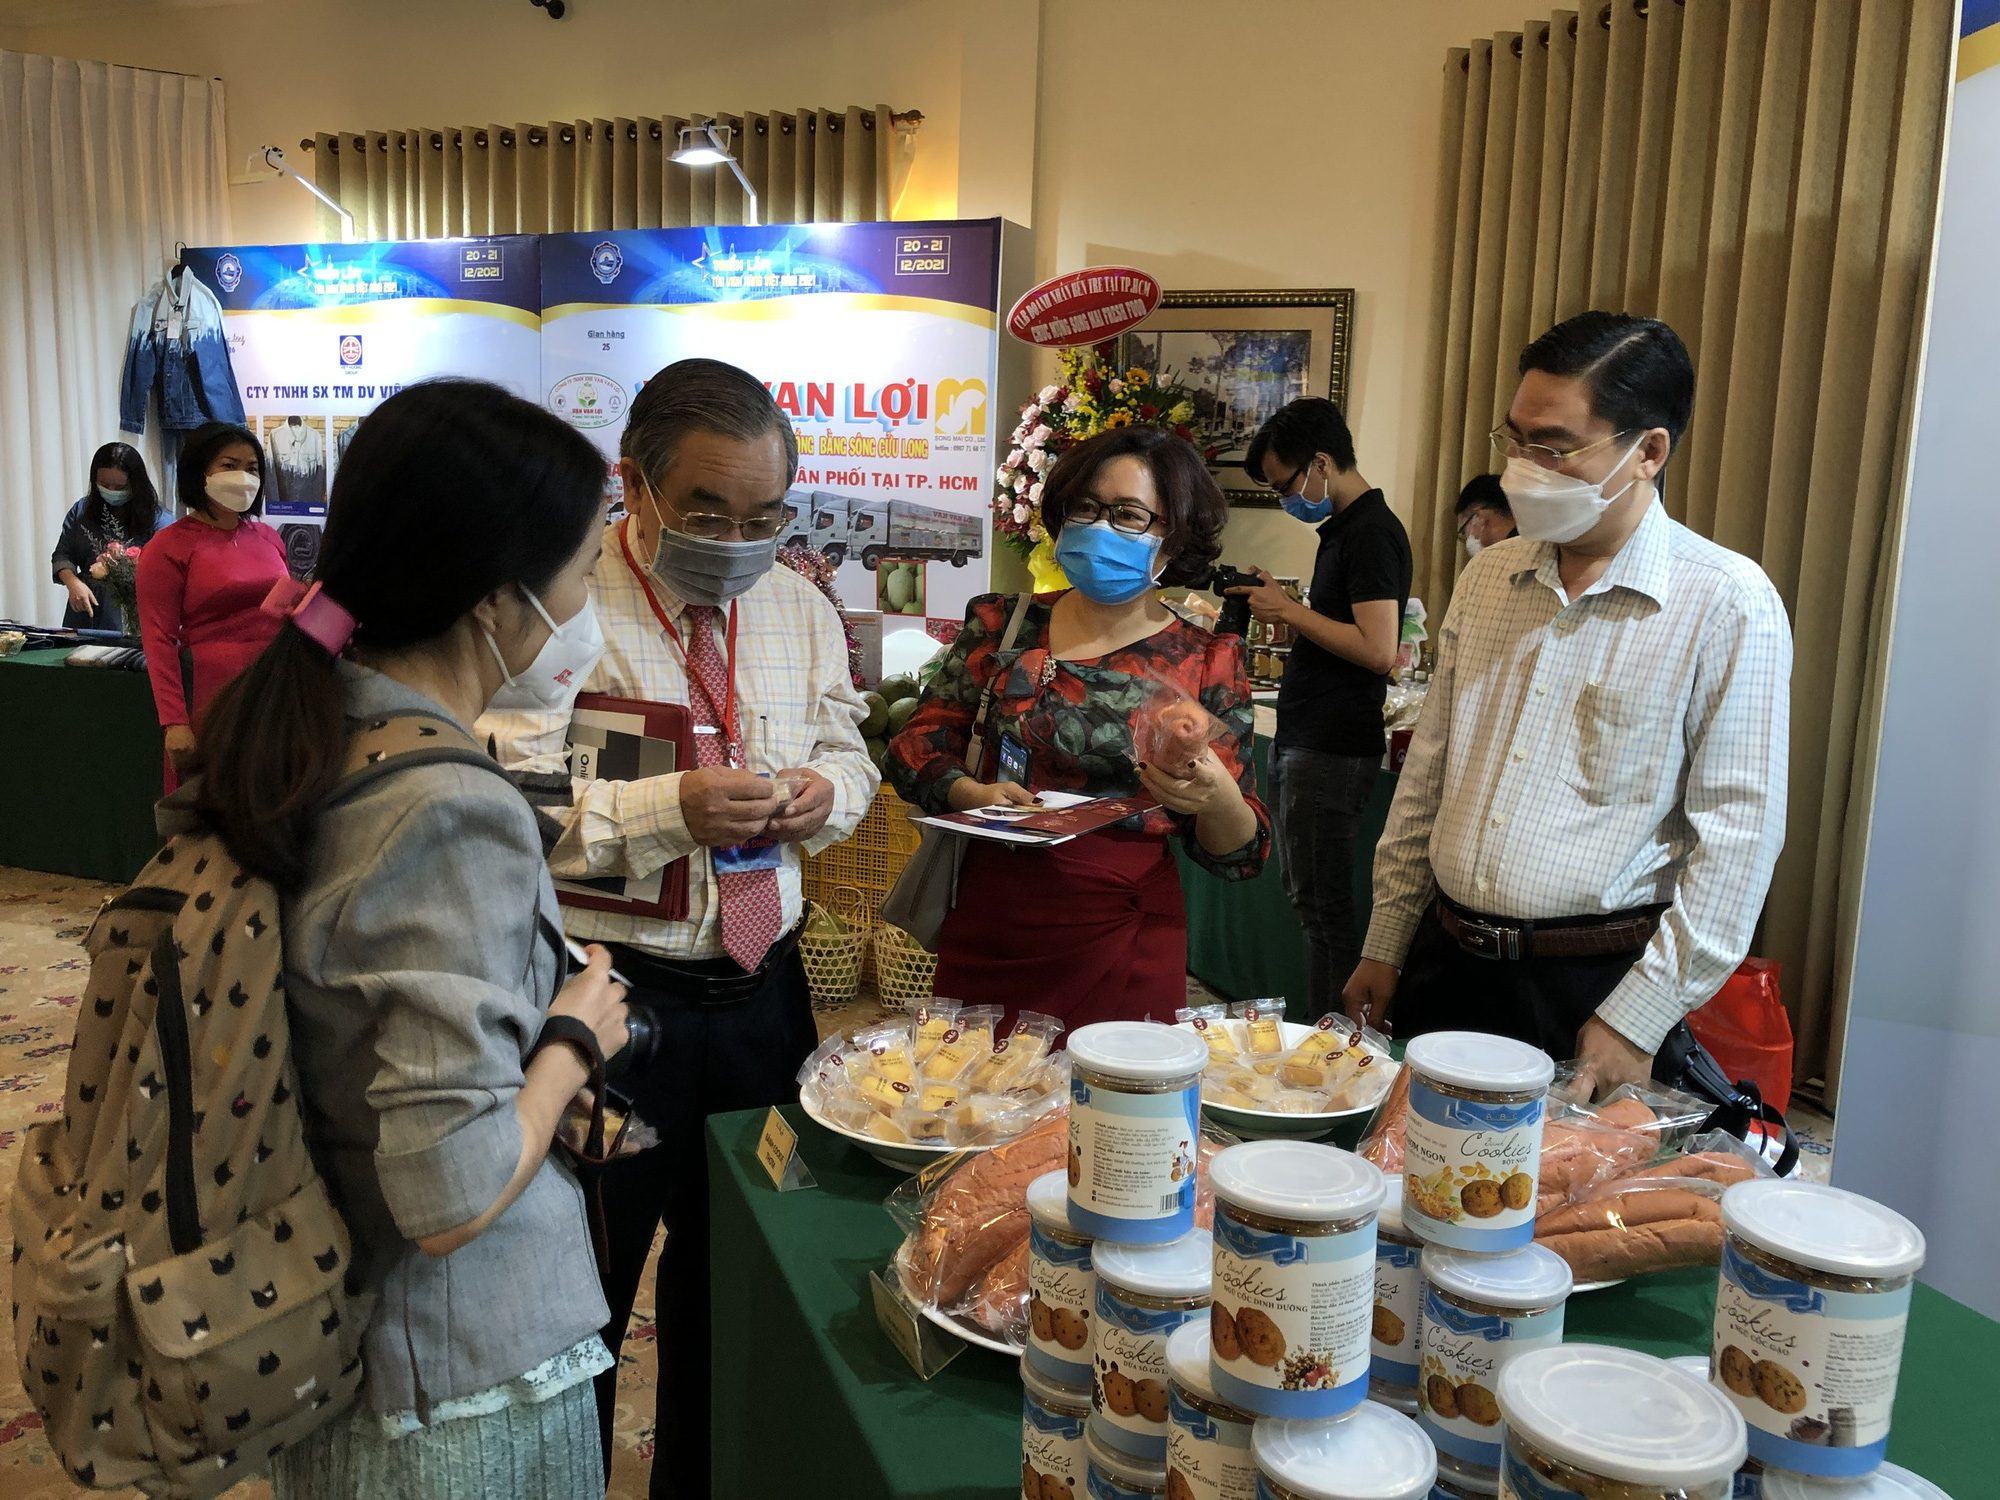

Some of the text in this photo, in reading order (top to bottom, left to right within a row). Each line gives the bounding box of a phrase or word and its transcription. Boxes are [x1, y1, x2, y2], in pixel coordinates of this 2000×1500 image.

[466, 250, 480, 261] 20
[903, 240, 921, 252] 20
[930, 239, 943, 251] 21
[463, 267, 500, 278] 12/2021
[901, 259, 945, 272] 12/2021
[1087, 276, 1104, 294] TRE
[1125, 298, 1148, 319] FOOD
[587, 330, 625, 339] Gian hàng
[602, 343, 611, 351] 25
[246, 385, 269, 399] CTY
[273, 385, 309, 399] TNHH
[313, 385, 328, 399] SX
[333, 385, 353, 399] TM
[358, 385, 376, 399] DV
[853, 377, 929, 427] LỢI
[848, 431, 877, 458] SÔNG
[900, 438, 929, 460] LONG
[826, 466, 866, 487] PHỐI
[871, 472, 900, 490] TẠI
[905, 474, 933, 490] TP.
[939, 475, 978, 491] HCM
[580, 753, 589, 779] Onli
[1420, 1146, 1446, 1163] NGON
[1460, 1131, 1533, 1158] Cookies
[1031, 1258, 1088, 1300] Cookies
[1214, 1250, 1288, 1302] Cookies
[1237, 1290, 1253, 1303] CỐC
[1254, 1298, 1275, 1309] DINH
[1276, 1303, 1308, 1313] DƯỠNG
[1720, 1283, 1798, 1348] Cookies
[1103, 1328, 1165, 1366] Cookie
[1427, 1325, 1495, 1370] Cookies
[1023, 1423, 1073, 1467] Cookies
